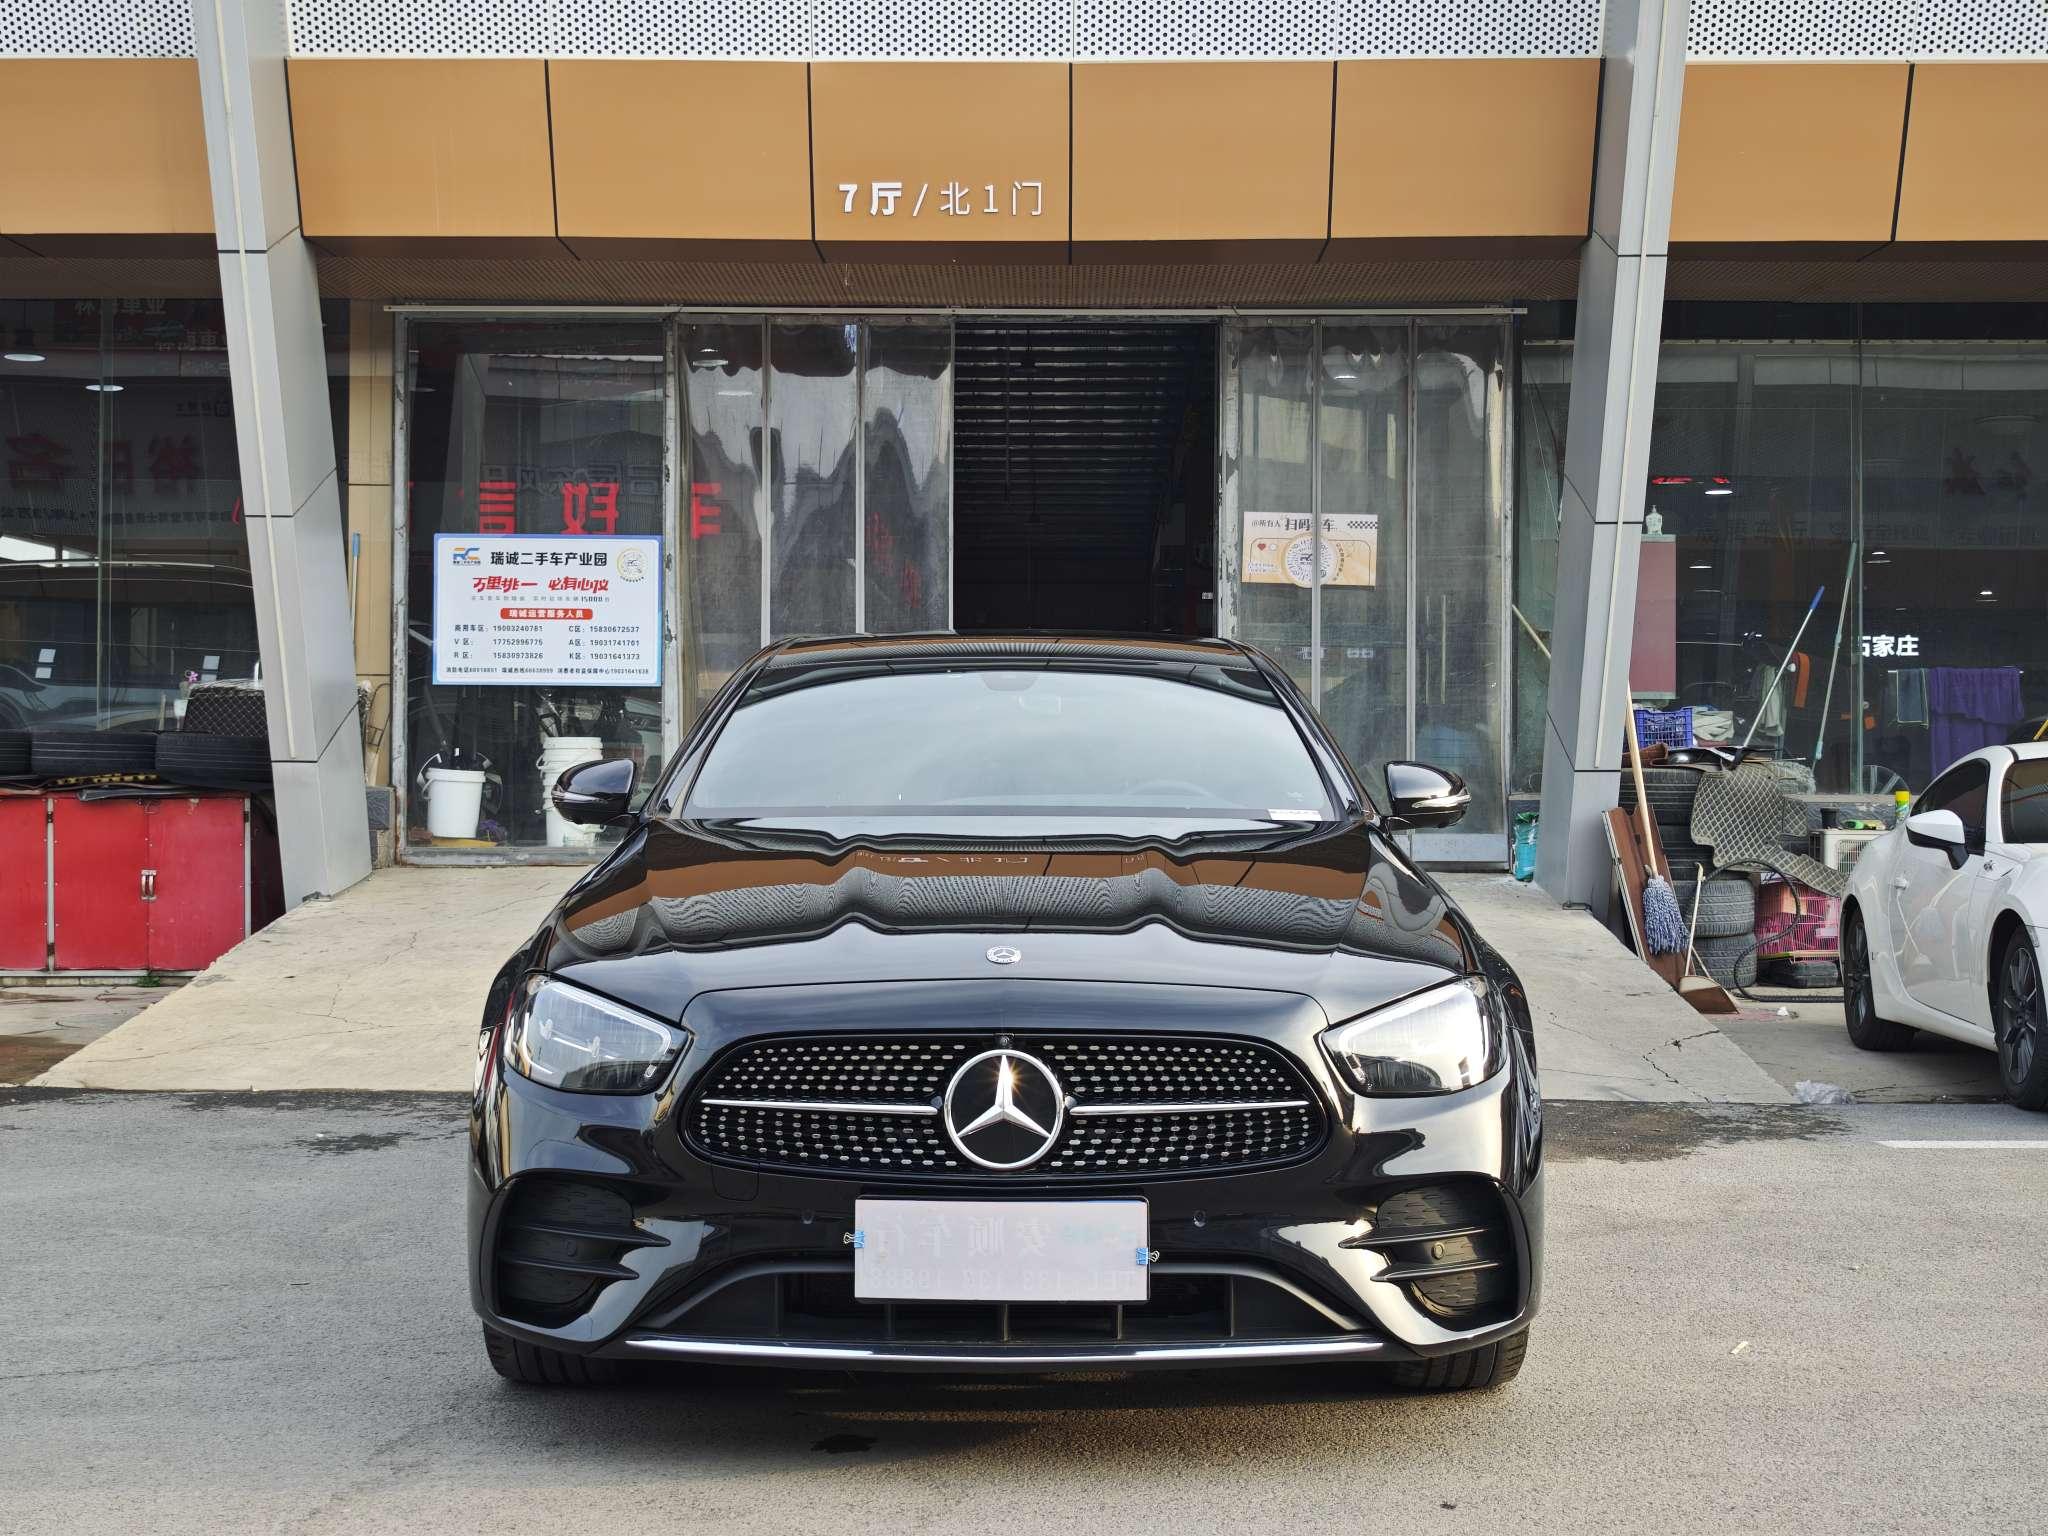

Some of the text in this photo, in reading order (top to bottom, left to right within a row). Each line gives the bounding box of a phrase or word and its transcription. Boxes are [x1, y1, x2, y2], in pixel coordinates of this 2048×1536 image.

[1284, 518, 1336, 532] 扫码车
[490, 551, 608, 567] 瑞诚二手车产业园
[472, 575, 609, 593] 万里挑一 必有心仪
[509, 608, 584, 619] 瑞诚运营服务人员
